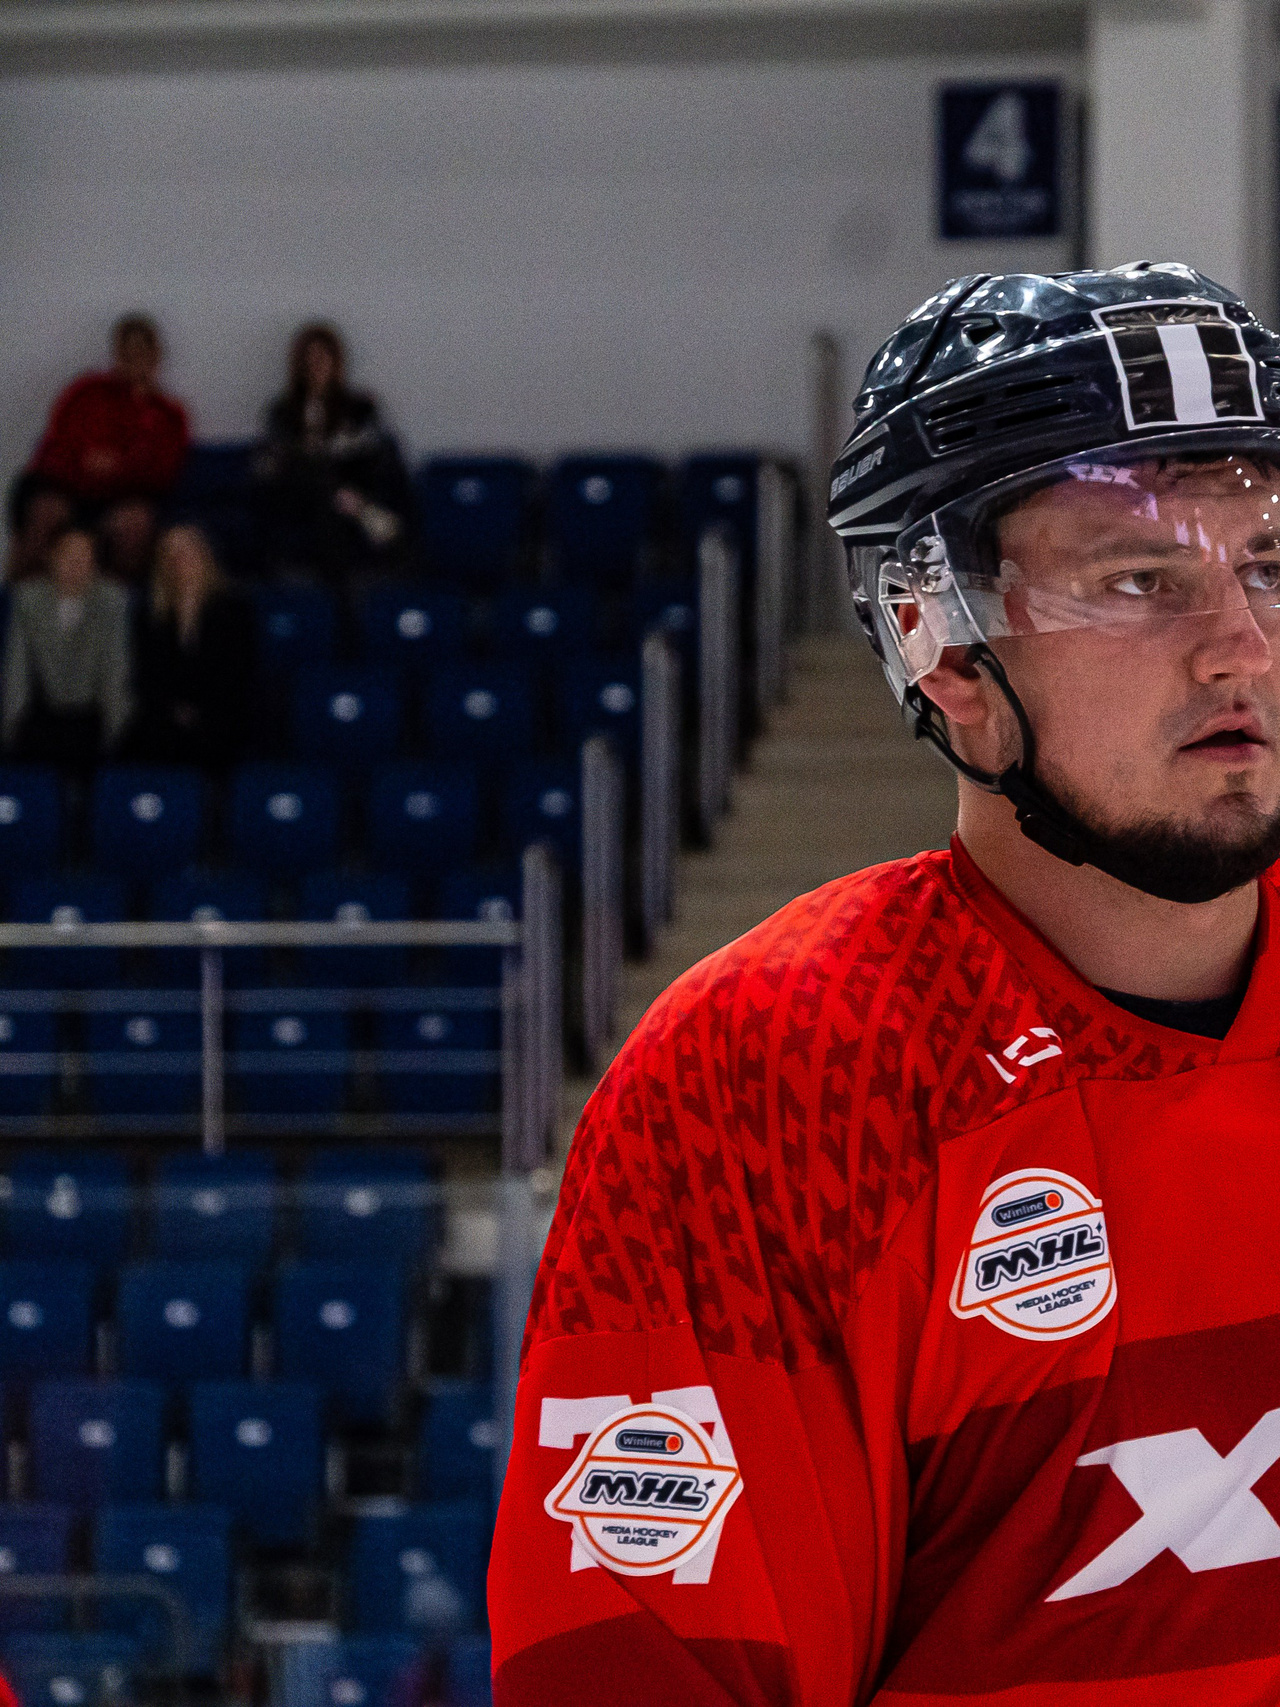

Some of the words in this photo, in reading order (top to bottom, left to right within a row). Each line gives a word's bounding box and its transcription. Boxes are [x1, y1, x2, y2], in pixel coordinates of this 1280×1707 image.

[963, 91, 1034, 181] 4
[999, 1202, 1044, 1220] Winline
[979, 1227, 1102, 1288] MHL
[1015, 1294, 1051, 1311] MEDIA
[1052, 1279, 1096, 1300] HOCKEY
[1038, 1294, 1083, 1314] LEAGUE
[622, 1436, 664, 1447] Winline
[582, 1473, 706, 1508] MHL
[602, 1525, 631, 1535] MEDIA
[632, 1527, 679, 1539] HOCKEY
[617, 1536, 658, 1547] LEAGUE
